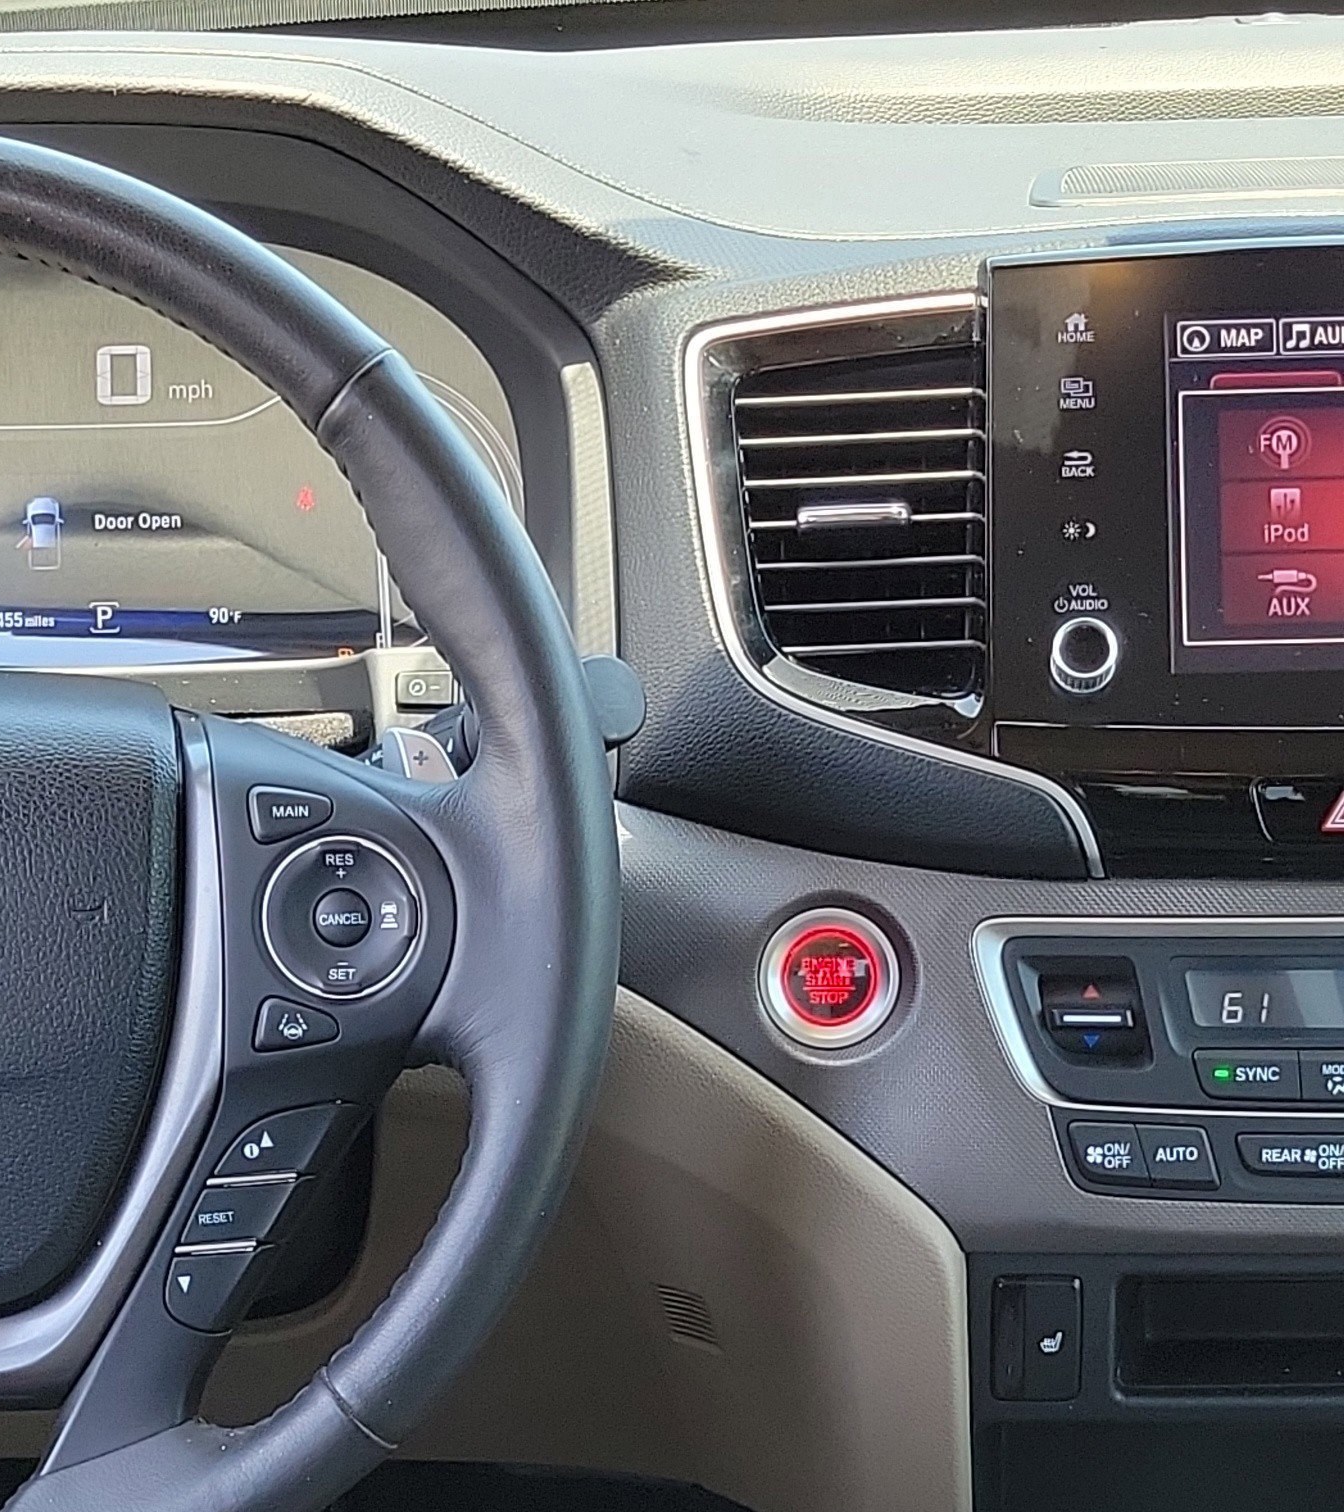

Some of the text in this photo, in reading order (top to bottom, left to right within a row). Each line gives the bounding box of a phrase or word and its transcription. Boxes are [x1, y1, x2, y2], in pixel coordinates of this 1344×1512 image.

[1057, 330, 1096, 343] HOME
[1219, 328, 1264, 348] MAP
[96, 344, 213, 406] 0 mph
[1059, 397, 1096, 409] MENU
[1061, 466, 1095, 478] BACK
[94, 513, 182, 531] Door Open
[1263, 523, 1309, 543] iPod
[1069, 584, 1098, 597] VOL
[1069, 598, 1109, 611] AUDIO
[1268, 598, 1310, 616] AUX
[24, 615, 56, 629] miles
[96, 606, 113, 629] P
[271, 805, 309, 818] MAIN
[325, 853, 354, 866] RES
[319, 914, 366, 926] CANCEL
[802, 957, 856, 971] ENGINE
[328, 968, 357, 981] SET
[809, 991, 850, 1004] STOP
[1221, 991, 1269, 1024] 61
[1235, 1067, 1280, 1082] SYNC
[1104, 1142, 1131, 1156] ON/
[1155, 1147, 1198, 1161] AUTO
[1261, 1148, 1301, 1163] REAR
[1104, 1156, 1132, 1169] OFF
[198, 1210, 235, 1226] RESET
